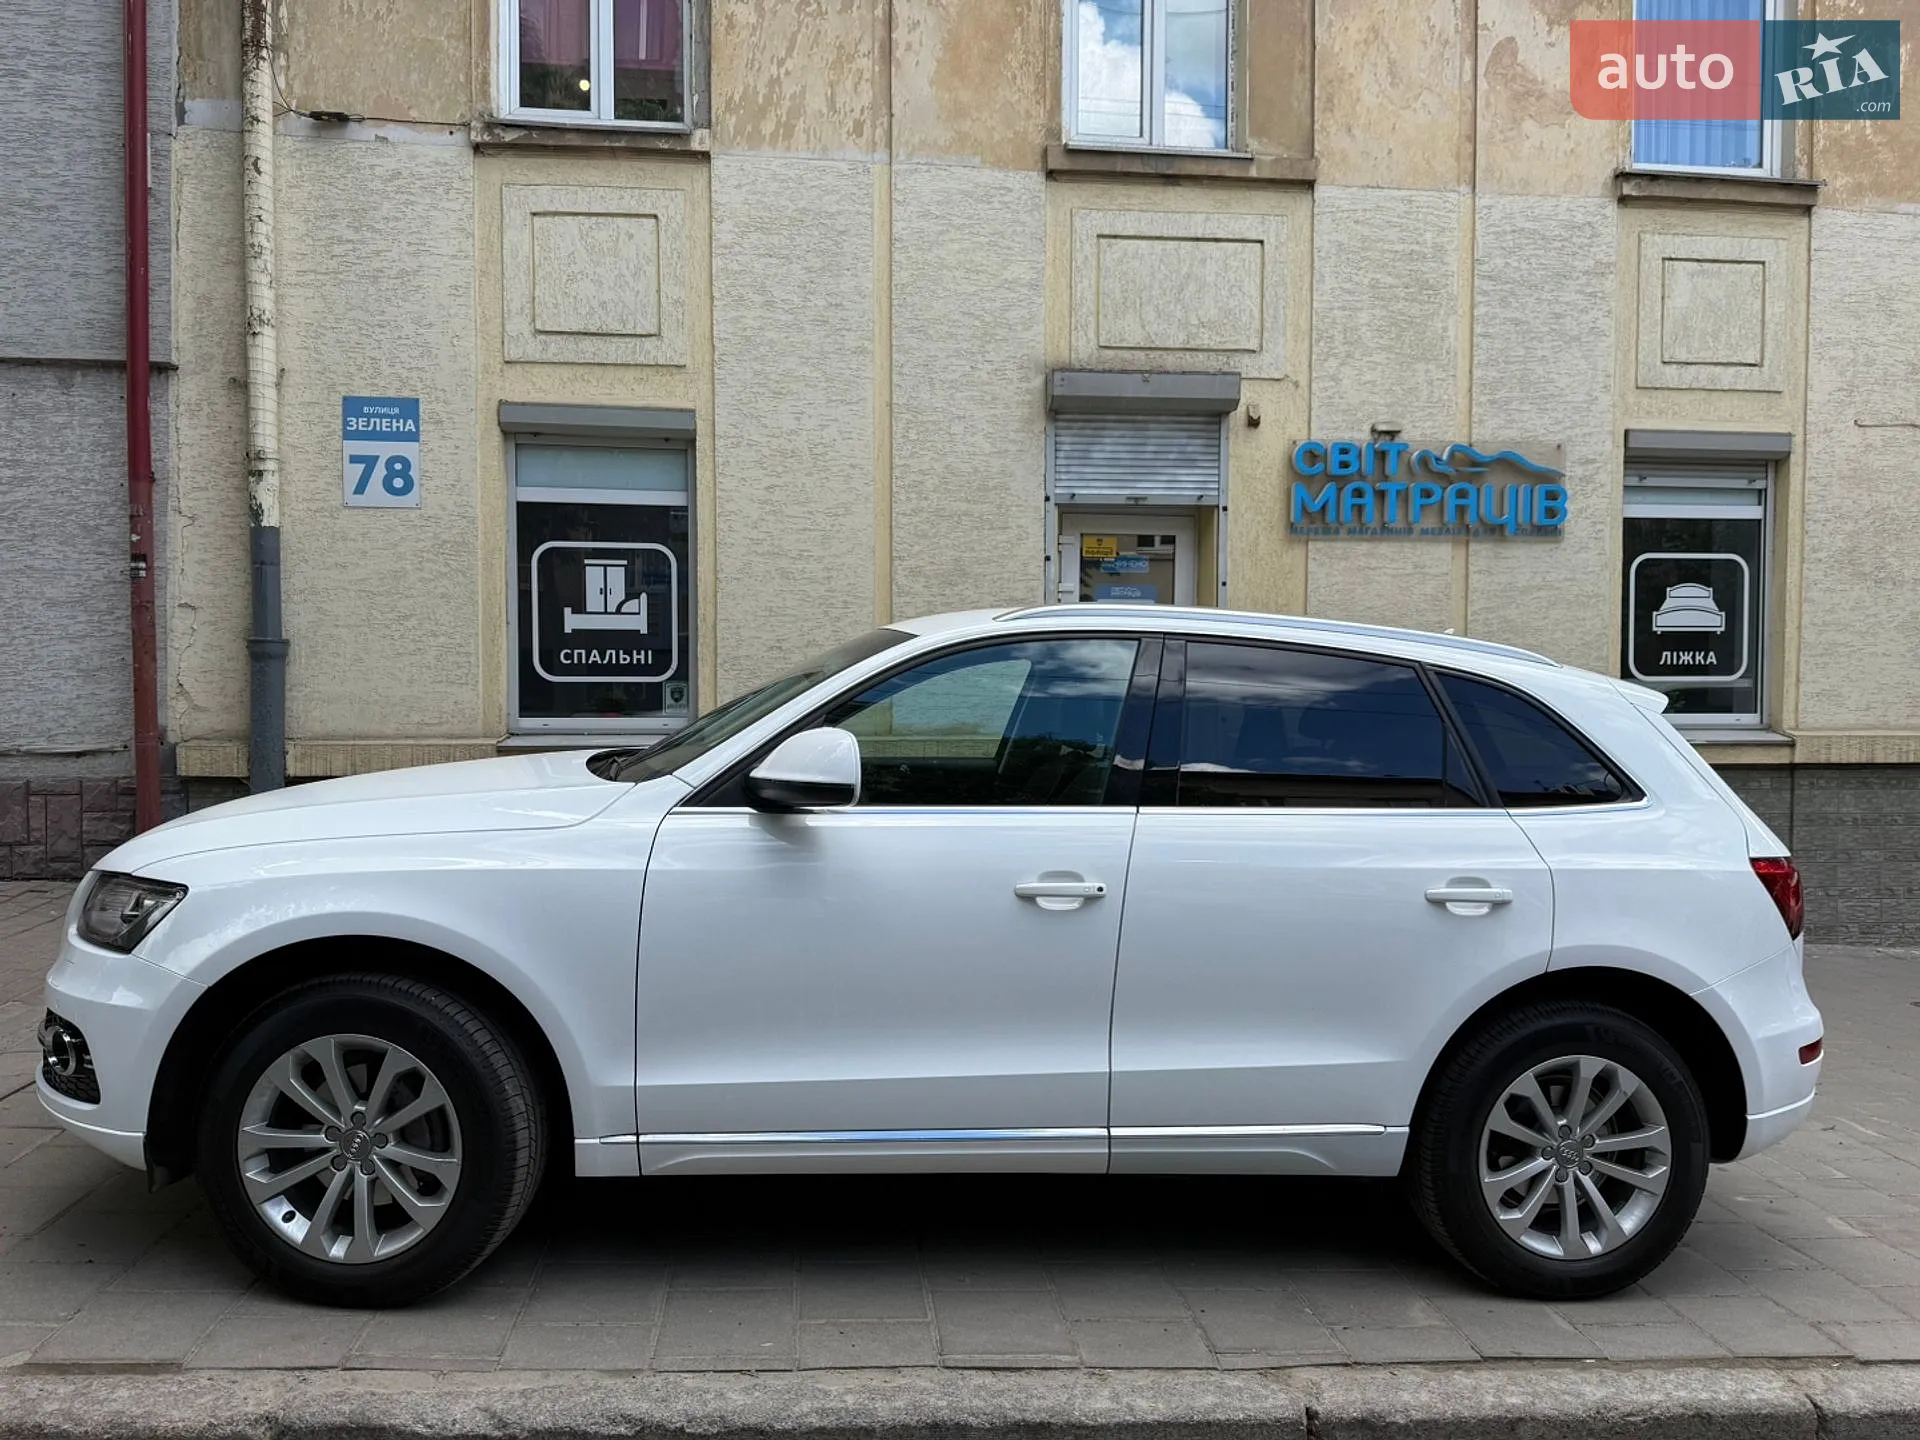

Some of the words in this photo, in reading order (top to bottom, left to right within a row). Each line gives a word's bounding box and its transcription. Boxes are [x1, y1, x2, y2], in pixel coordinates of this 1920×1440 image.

[346, 417, 416, 432] ЗЕЛЕНА
[1292, 441, 1409, 477] СВІТ
[349, 454, 415, 497] 78
[1290, 481, 1568, 536] МАТРАЦІВ
[560, 649, 652, 664] СПАЛЬНІ
[1659, 651, 1717, 665] ЛІЖКА
